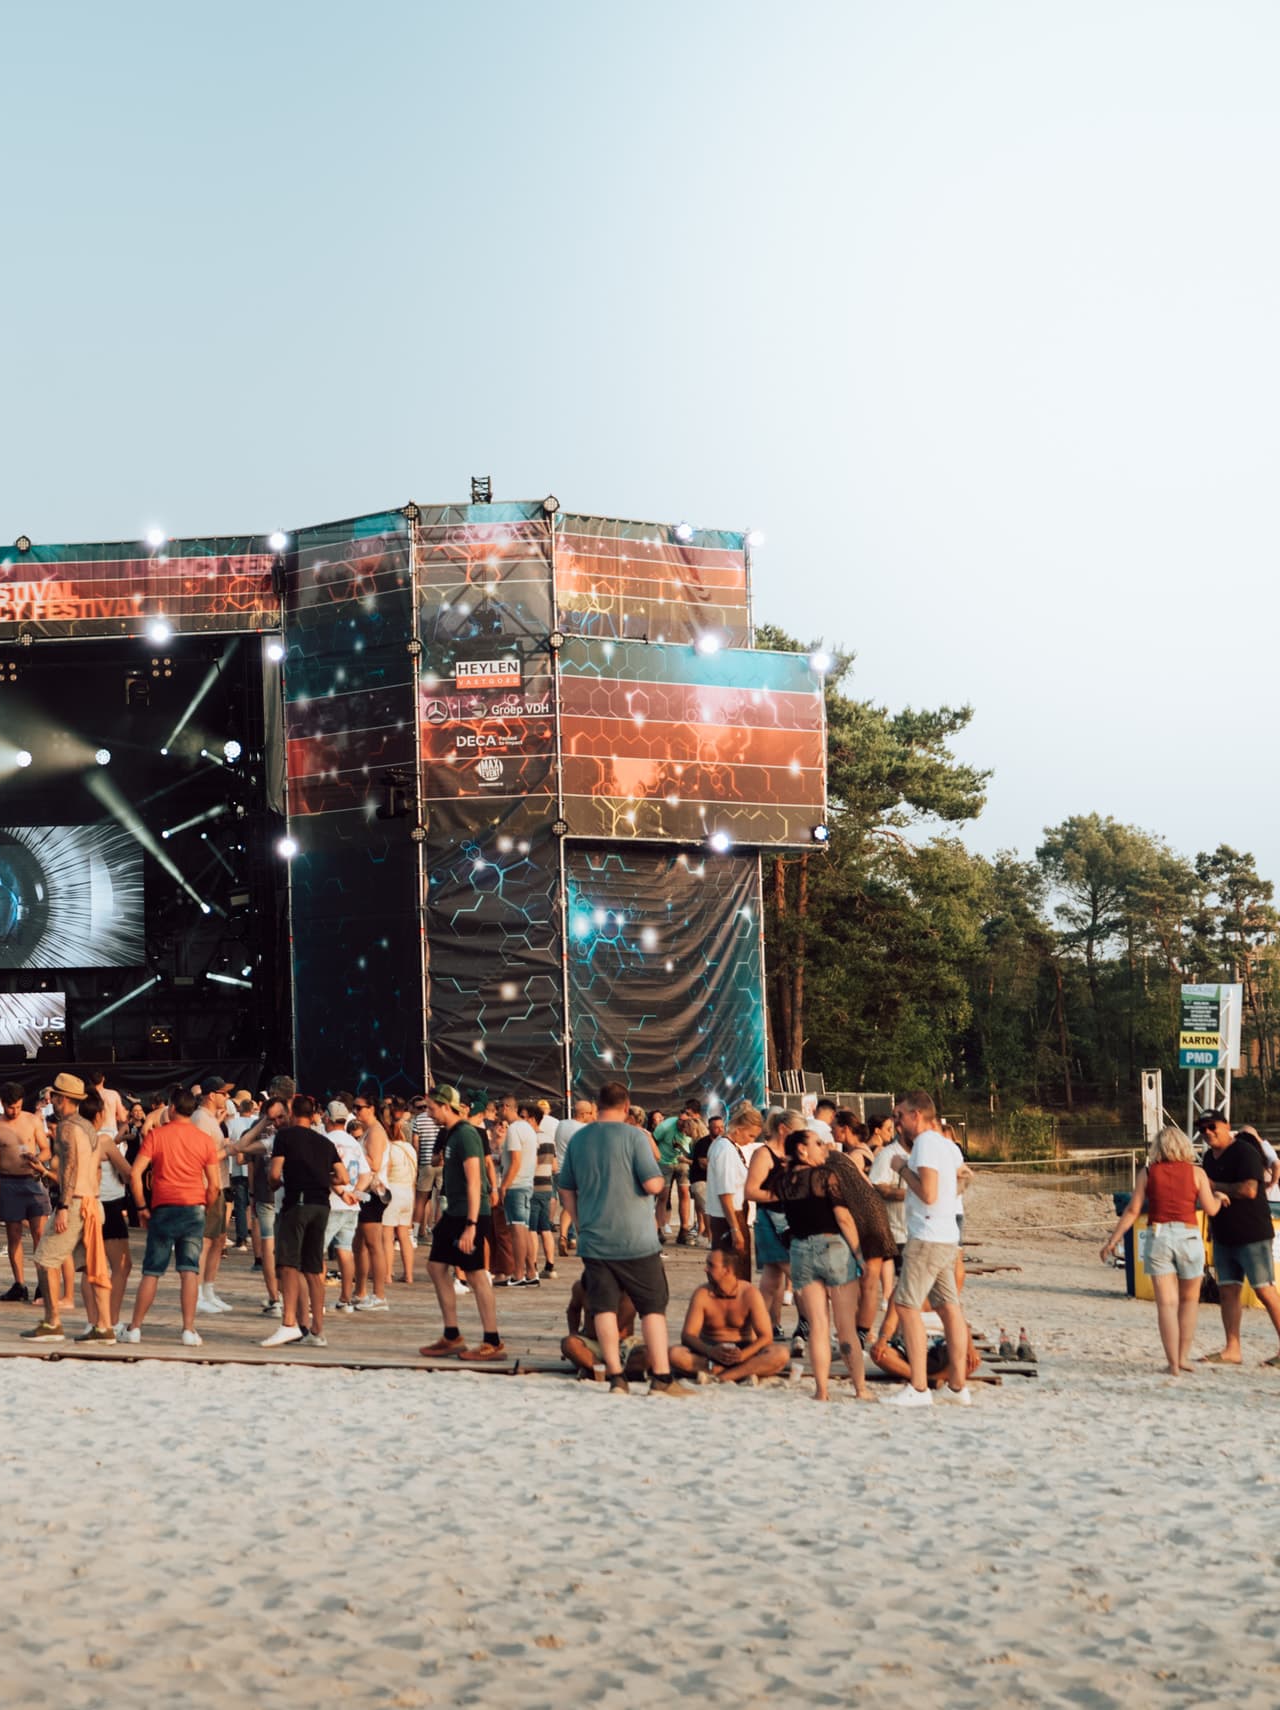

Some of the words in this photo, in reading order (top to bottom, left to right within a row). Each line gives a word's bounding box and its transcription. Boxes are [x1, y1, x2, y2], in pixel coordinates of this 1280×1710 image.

[32, 598, 144, 620] FESTIVAL
[458, 662, 518, 675] HEYLEN
[491, 705, 523, 715] Groep
[525, 704, 549, 714] VDH
[456, 735, 497, 747] DECA
[480, 758, 499, 770] MAX
[16, 1016, 65, 1030] RUS
[1182, 1035, 1218, 1045] KARTON
[1186, 1052, 1213, 1064] PMD
